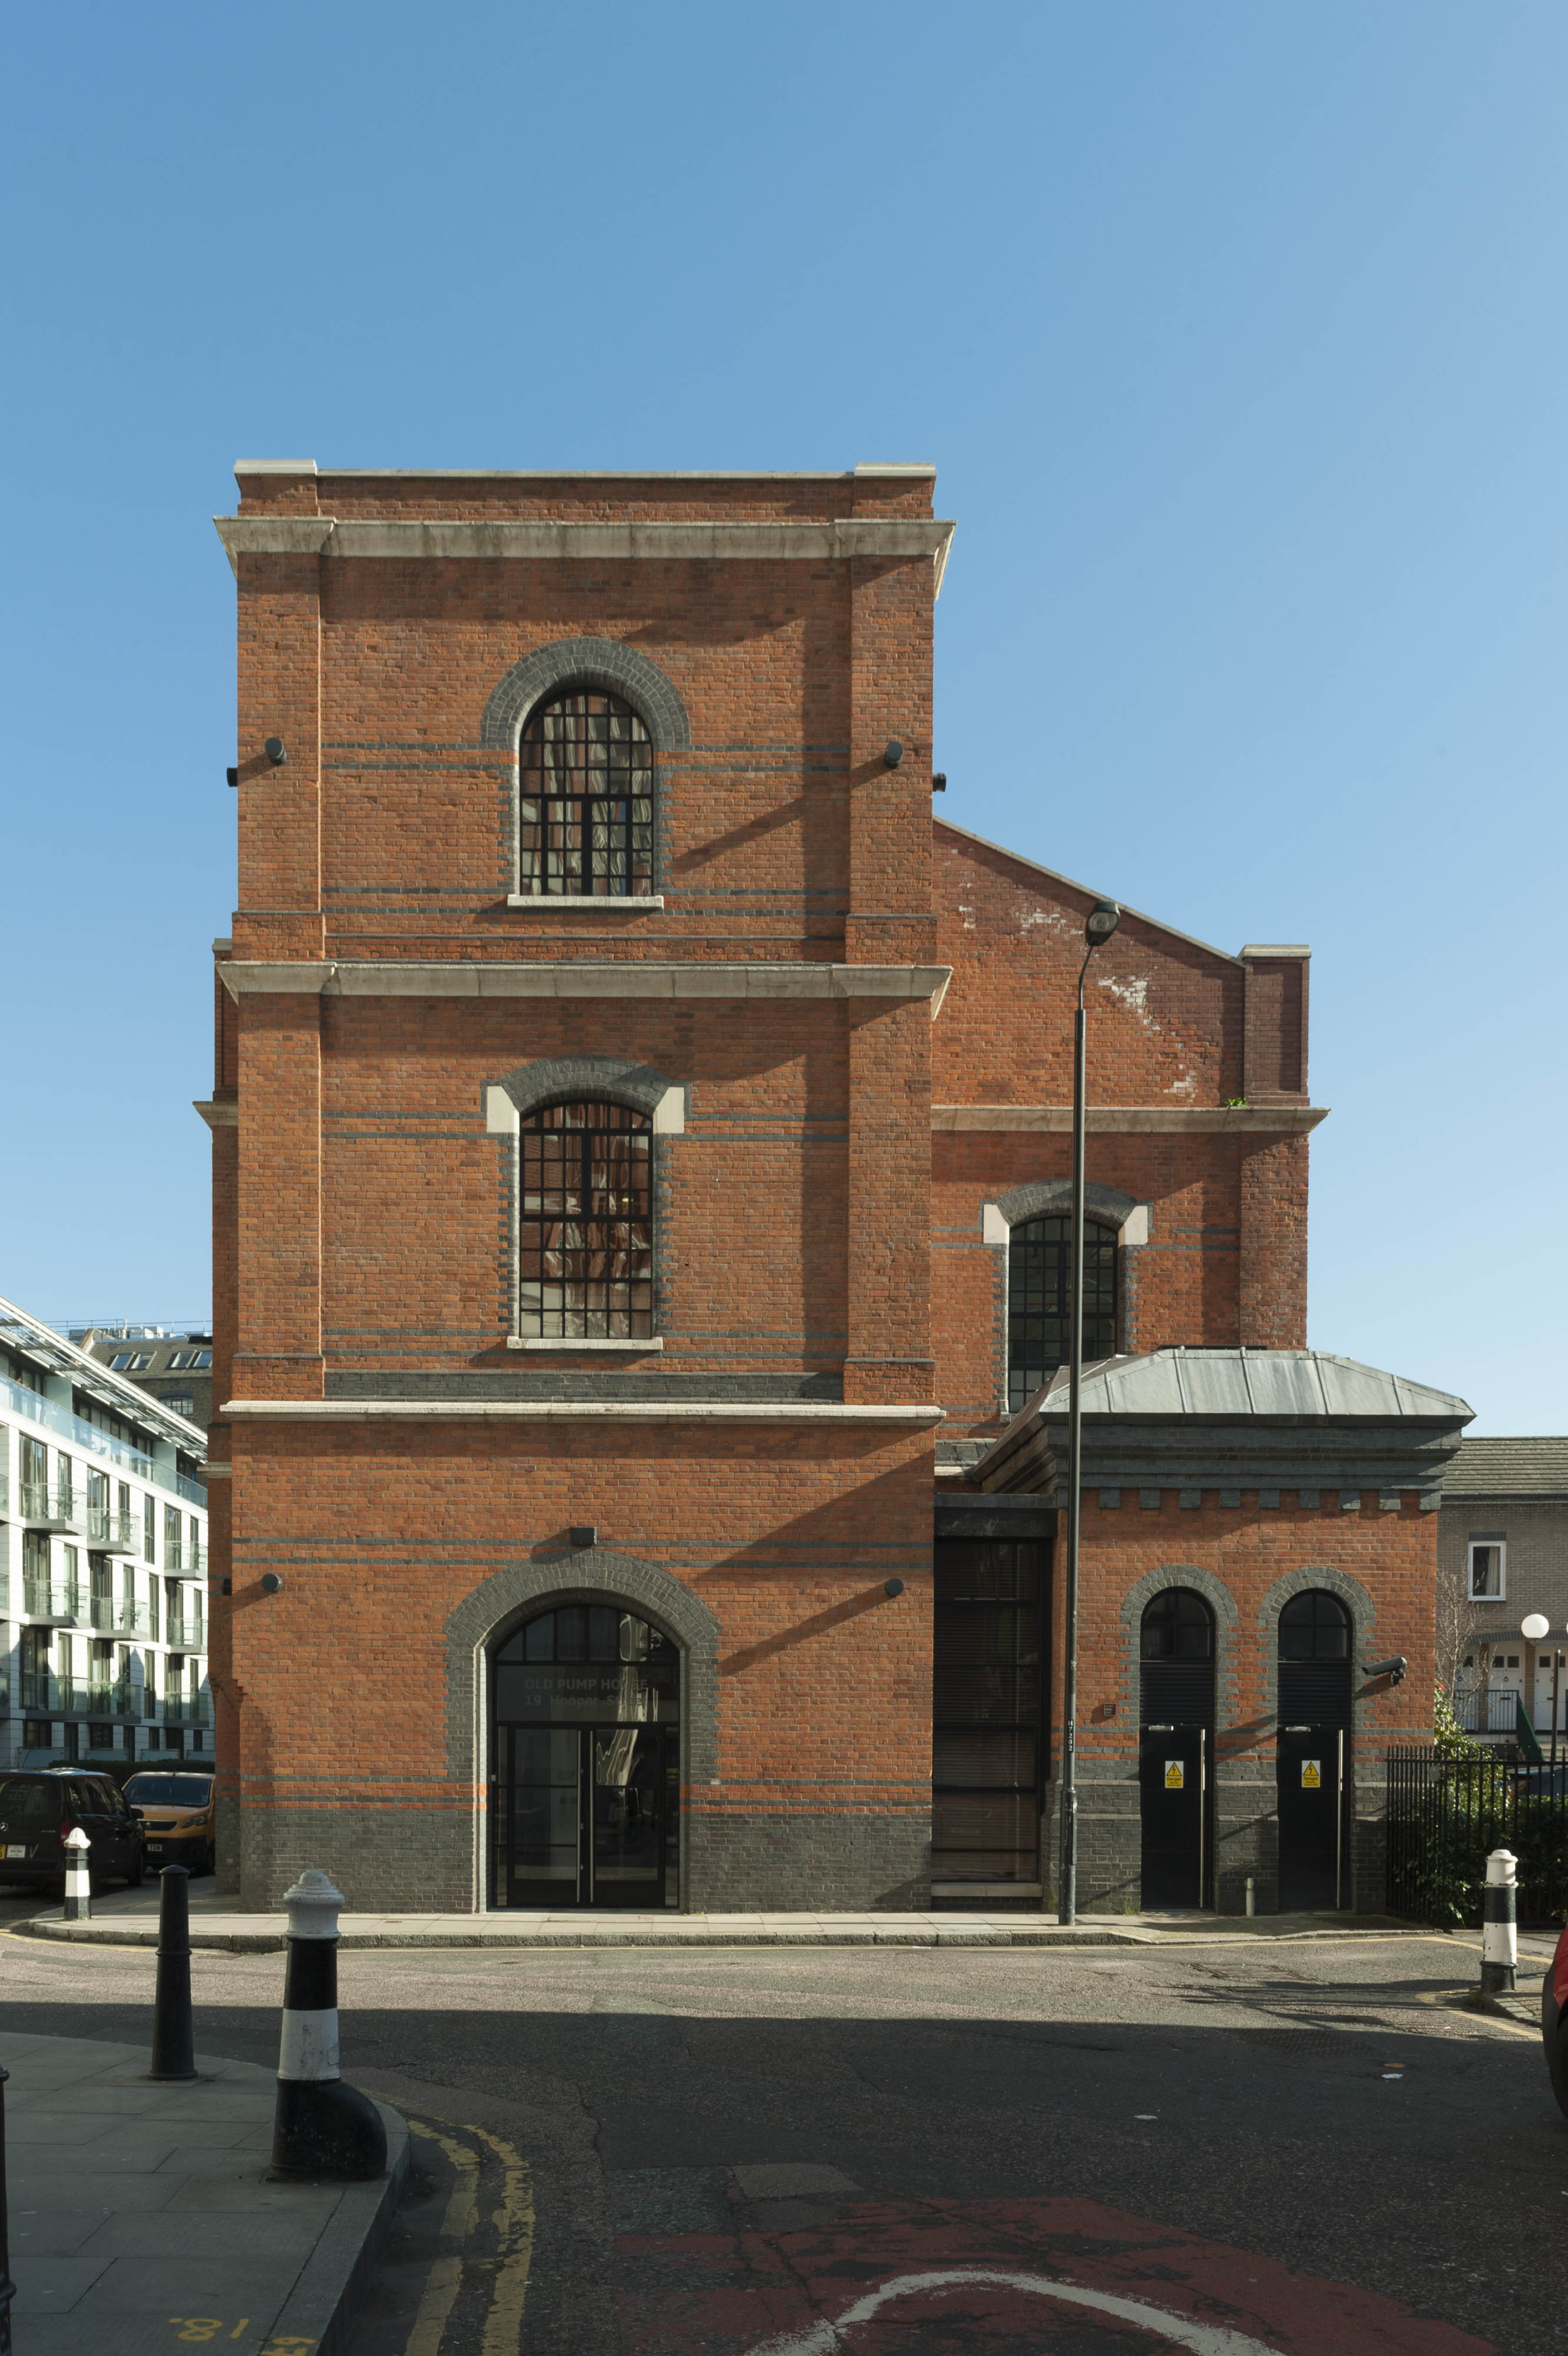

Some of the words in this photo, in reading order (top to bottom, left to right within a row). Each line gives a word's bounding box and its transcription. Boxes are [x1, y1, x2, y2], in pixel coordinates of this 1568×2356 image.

[525, 1678, 553, 1690] OLD
[557, 1678, 597, 1690] PUMP
[601, 1678, 648, 1690] HOSE
[525, 1695, 542, 1706] 19
[550, 1695, 599, 1708] Hooper
